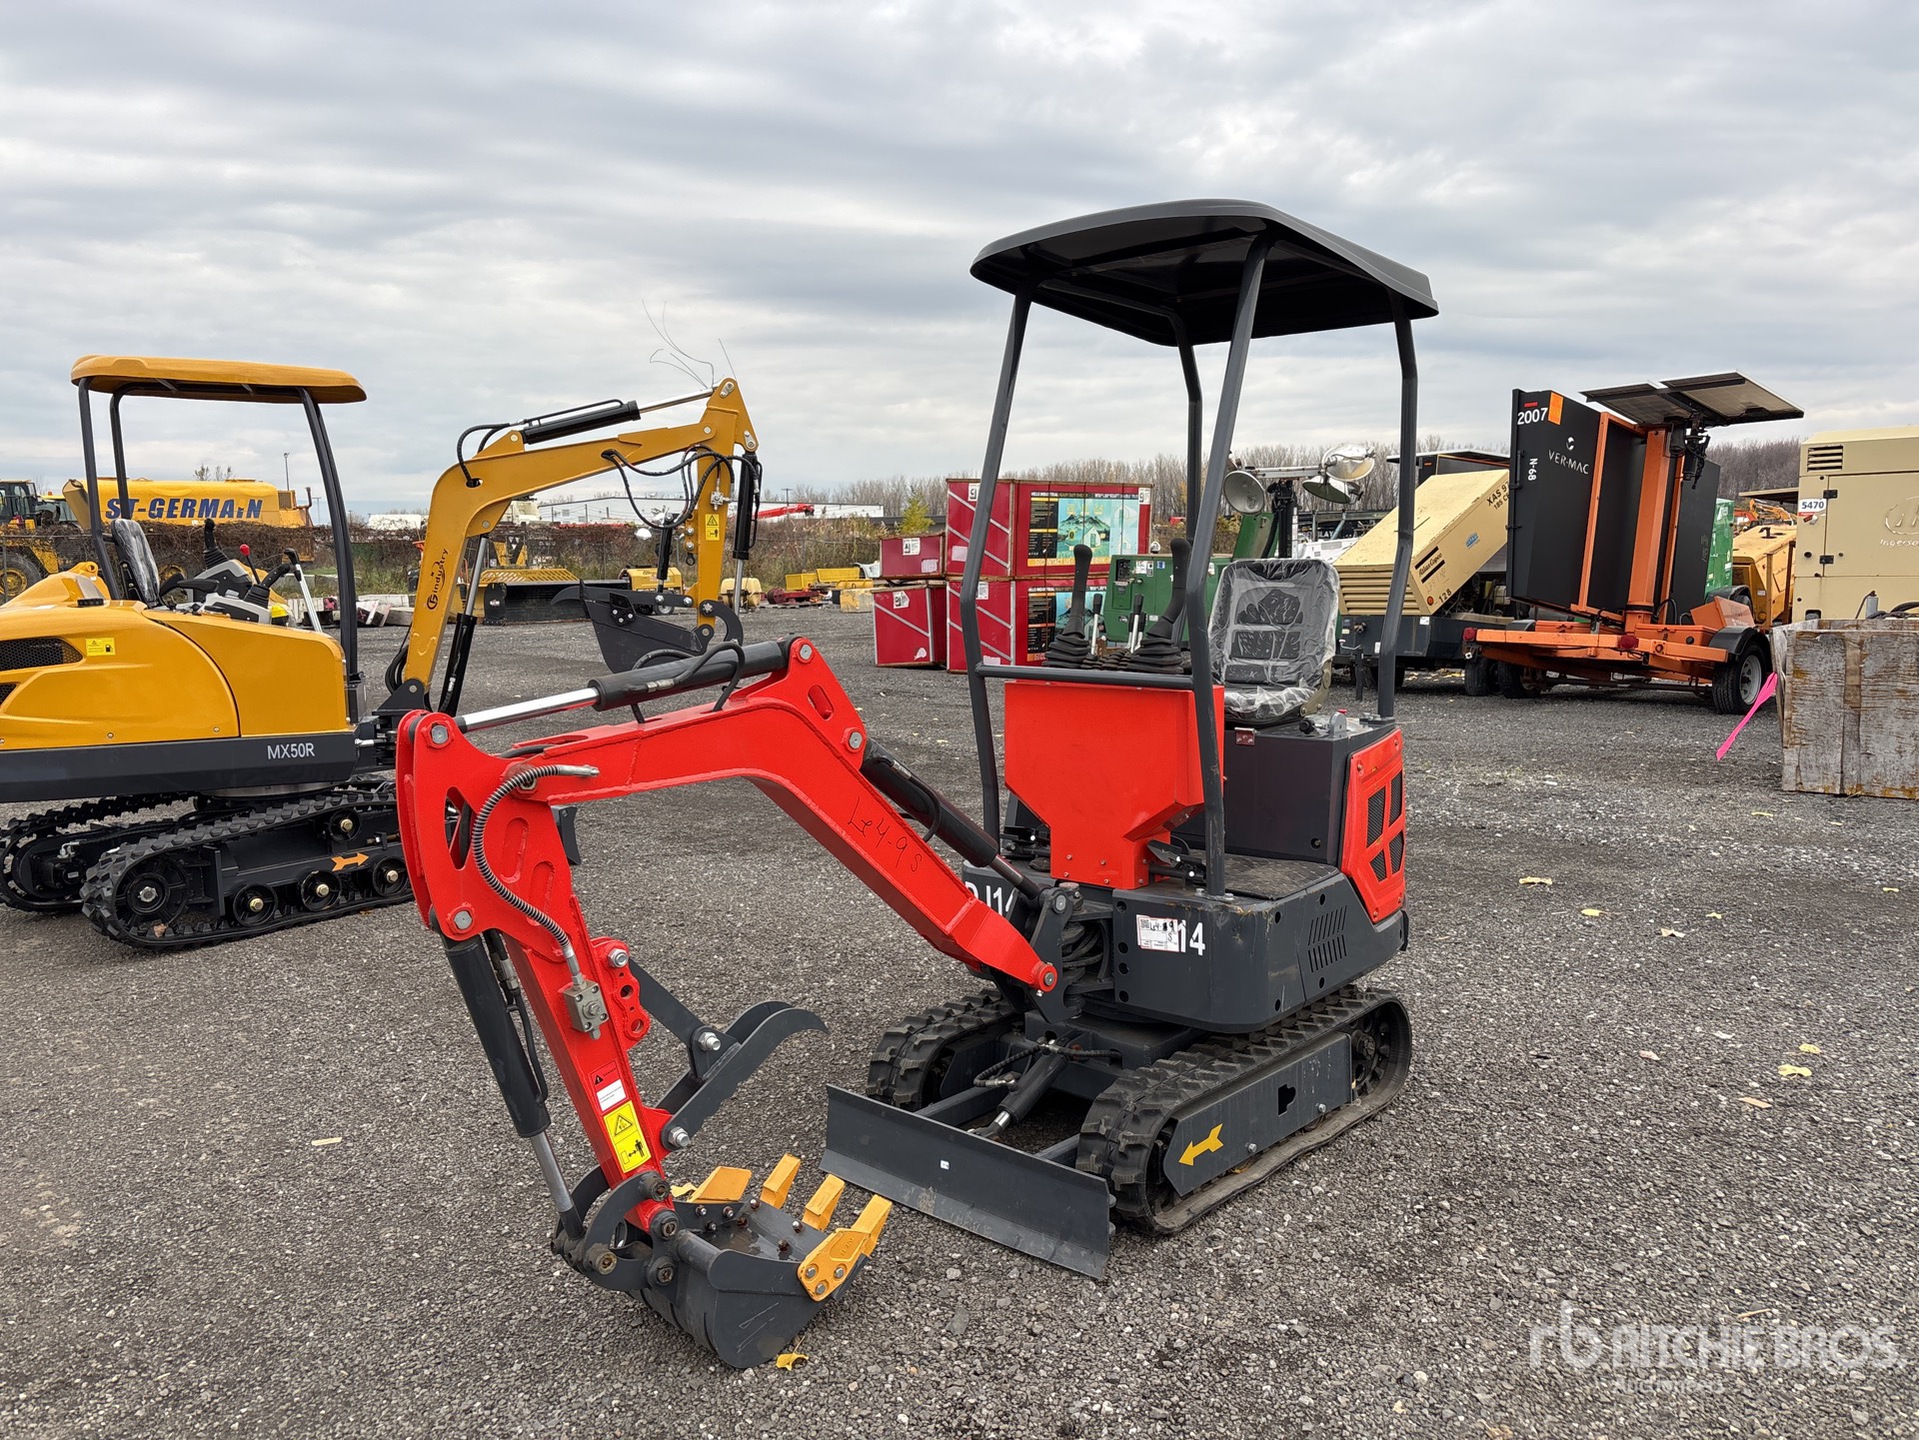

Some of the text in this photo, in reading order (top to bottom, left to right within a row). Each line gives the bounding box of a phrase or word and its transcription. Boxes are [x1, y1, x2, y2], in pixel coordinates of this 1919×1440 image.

[1517, 407, 1548, 425] 2007
[1528, 458, 1538, 480] N-68
[1548, 449, 1589, 474] VER-MAC
[1486, 489, 1502, 507] XAS
[1801, 501, 1824, 509] 5470
[1439, 588, 1451, 603] 128
[267, 742, 315, 760] MX50R
